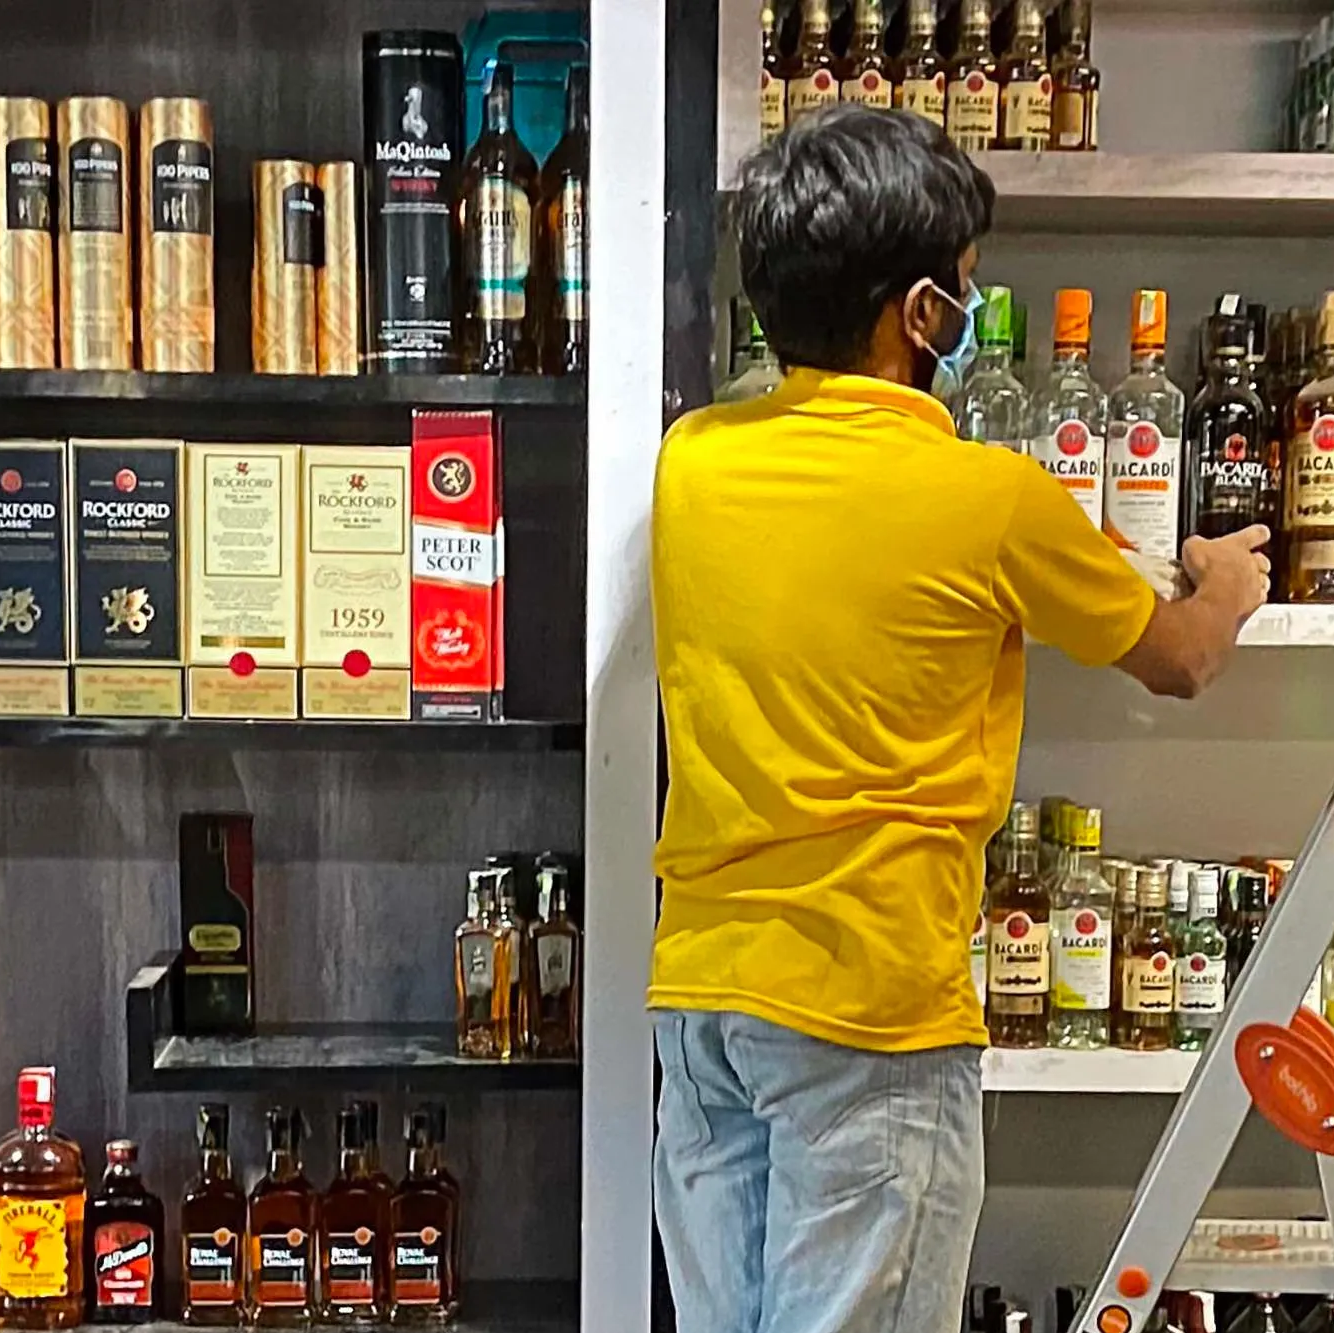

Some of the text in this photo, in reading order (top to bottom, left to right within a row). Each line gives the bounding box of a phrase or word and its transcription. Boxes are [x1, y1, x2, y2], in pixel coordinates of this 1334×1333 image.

[376, 141, 451, 162] MaQintosh
[11, 162, 30, 177] 100
[157, 163, 209, 181] 100 PIPERS
[83, 501, 170, 519] ROCKFORD
[318, 494, 397, 509] ROCKFORD
[107, 518, 146, 528] CLASSIC
[421, 537, 482, 555] PETER
[426, 555, 476, 572] SCOT
[331, 608, 385, 628] 1959
[1, 1204, 57, 1227] FIREBALL
